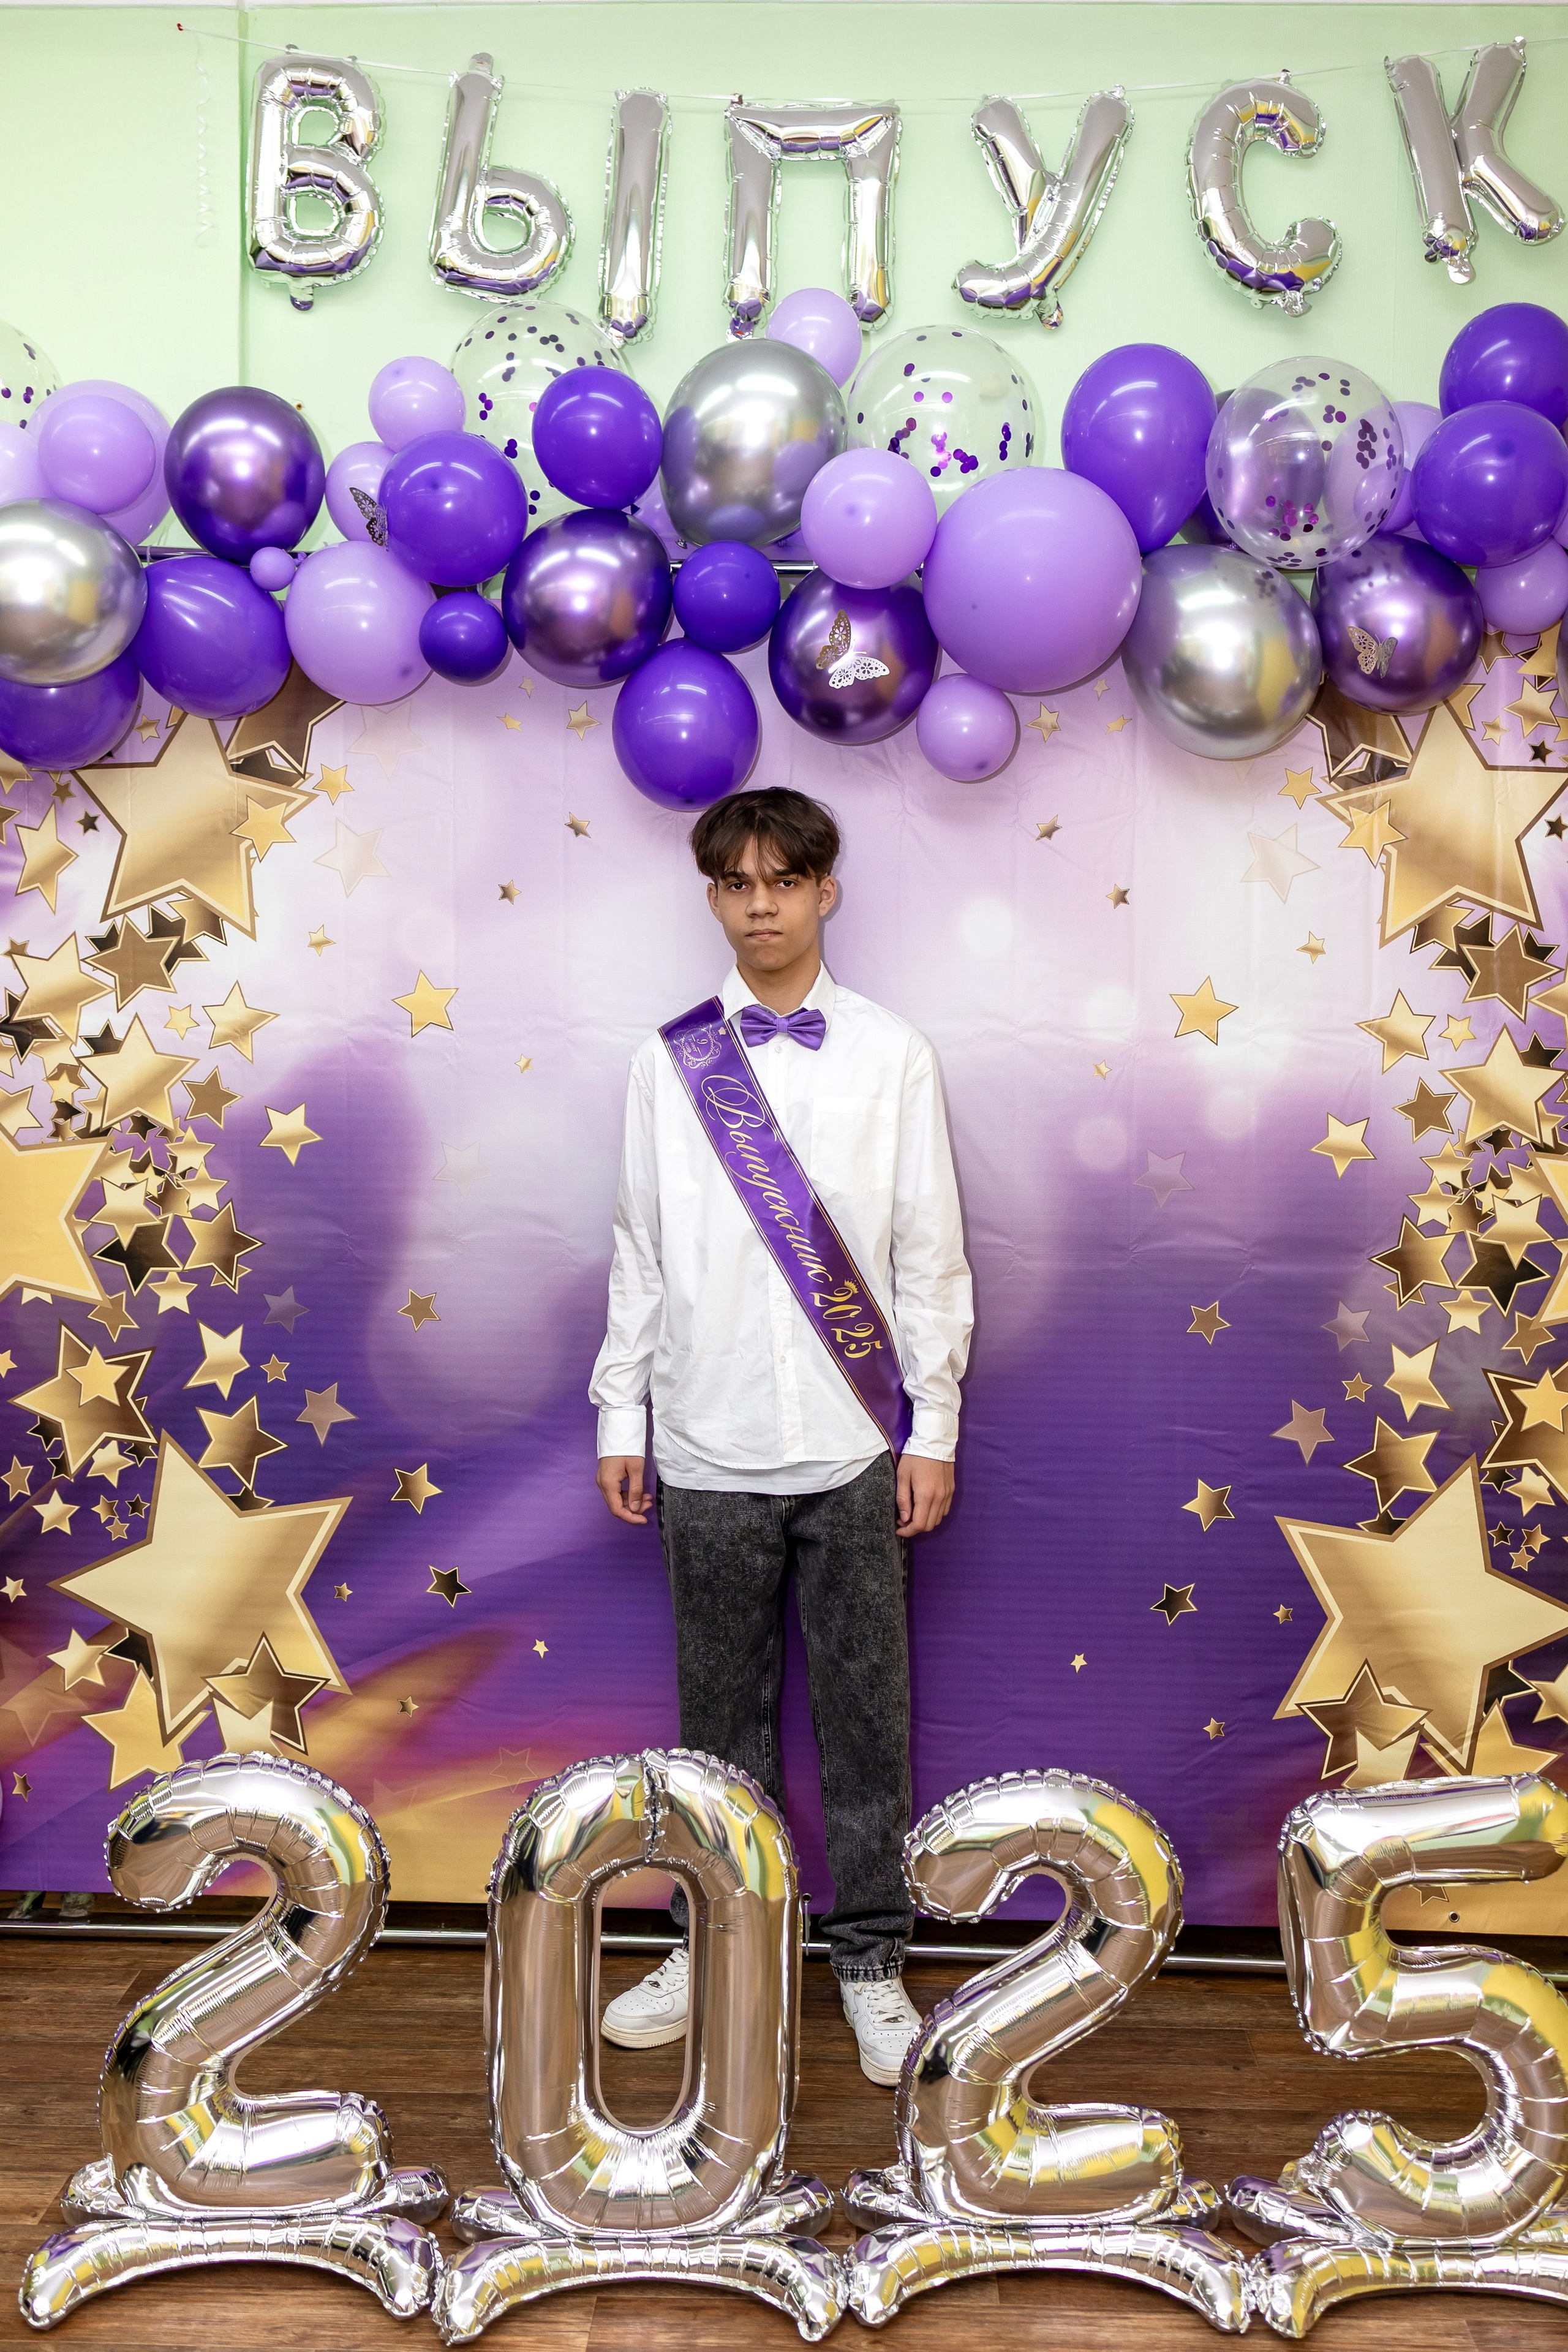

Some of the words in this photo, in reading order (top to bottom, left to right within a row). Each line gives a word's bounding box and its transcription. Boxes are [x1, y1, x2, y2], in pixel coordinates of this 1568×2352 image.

[701, 1074, 833, 1284] Выпускник
[809, 1287, 883, 1359] 2025
[97, 1748, 1568, 2247] 2025
